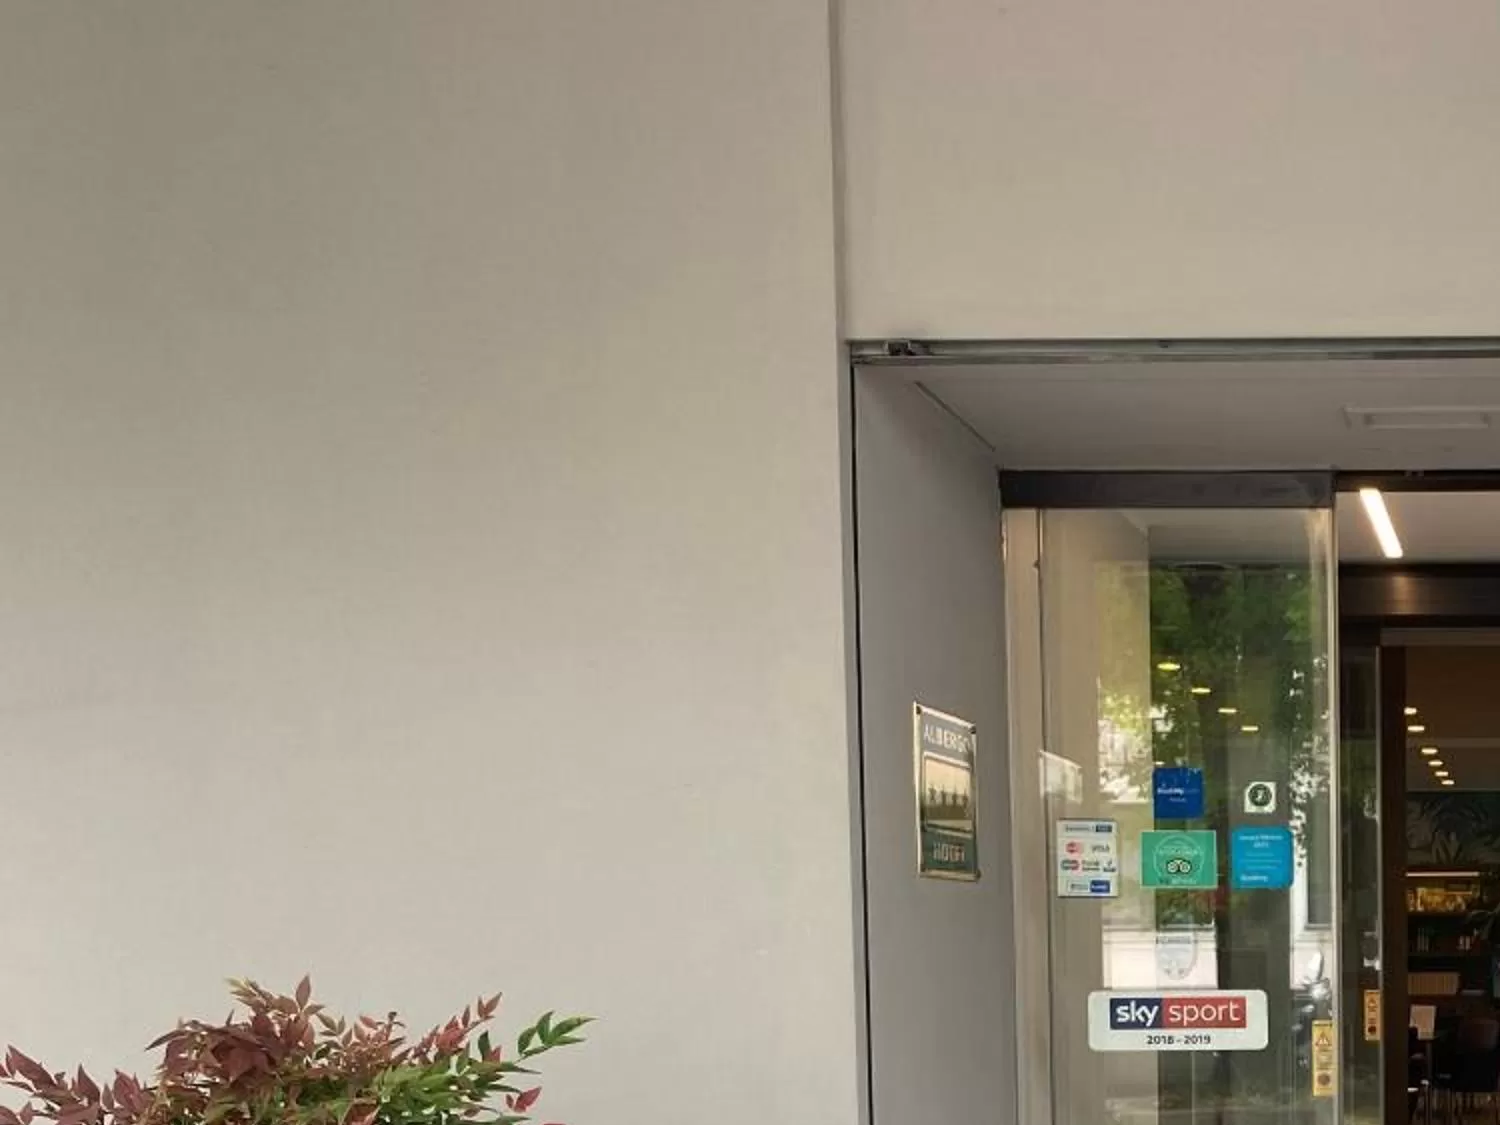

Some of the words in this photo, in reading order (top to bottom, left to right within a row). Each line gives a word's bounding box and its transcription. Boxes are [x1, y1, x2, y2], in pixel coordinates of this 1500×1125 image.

[1115, 1000, 1159, 1027] sky
[1168, 1001, 1241, 1026] sport
[1147, 1035, 1175, 1045] 2018
[1184, 1035, 1211, 1045] 2019
